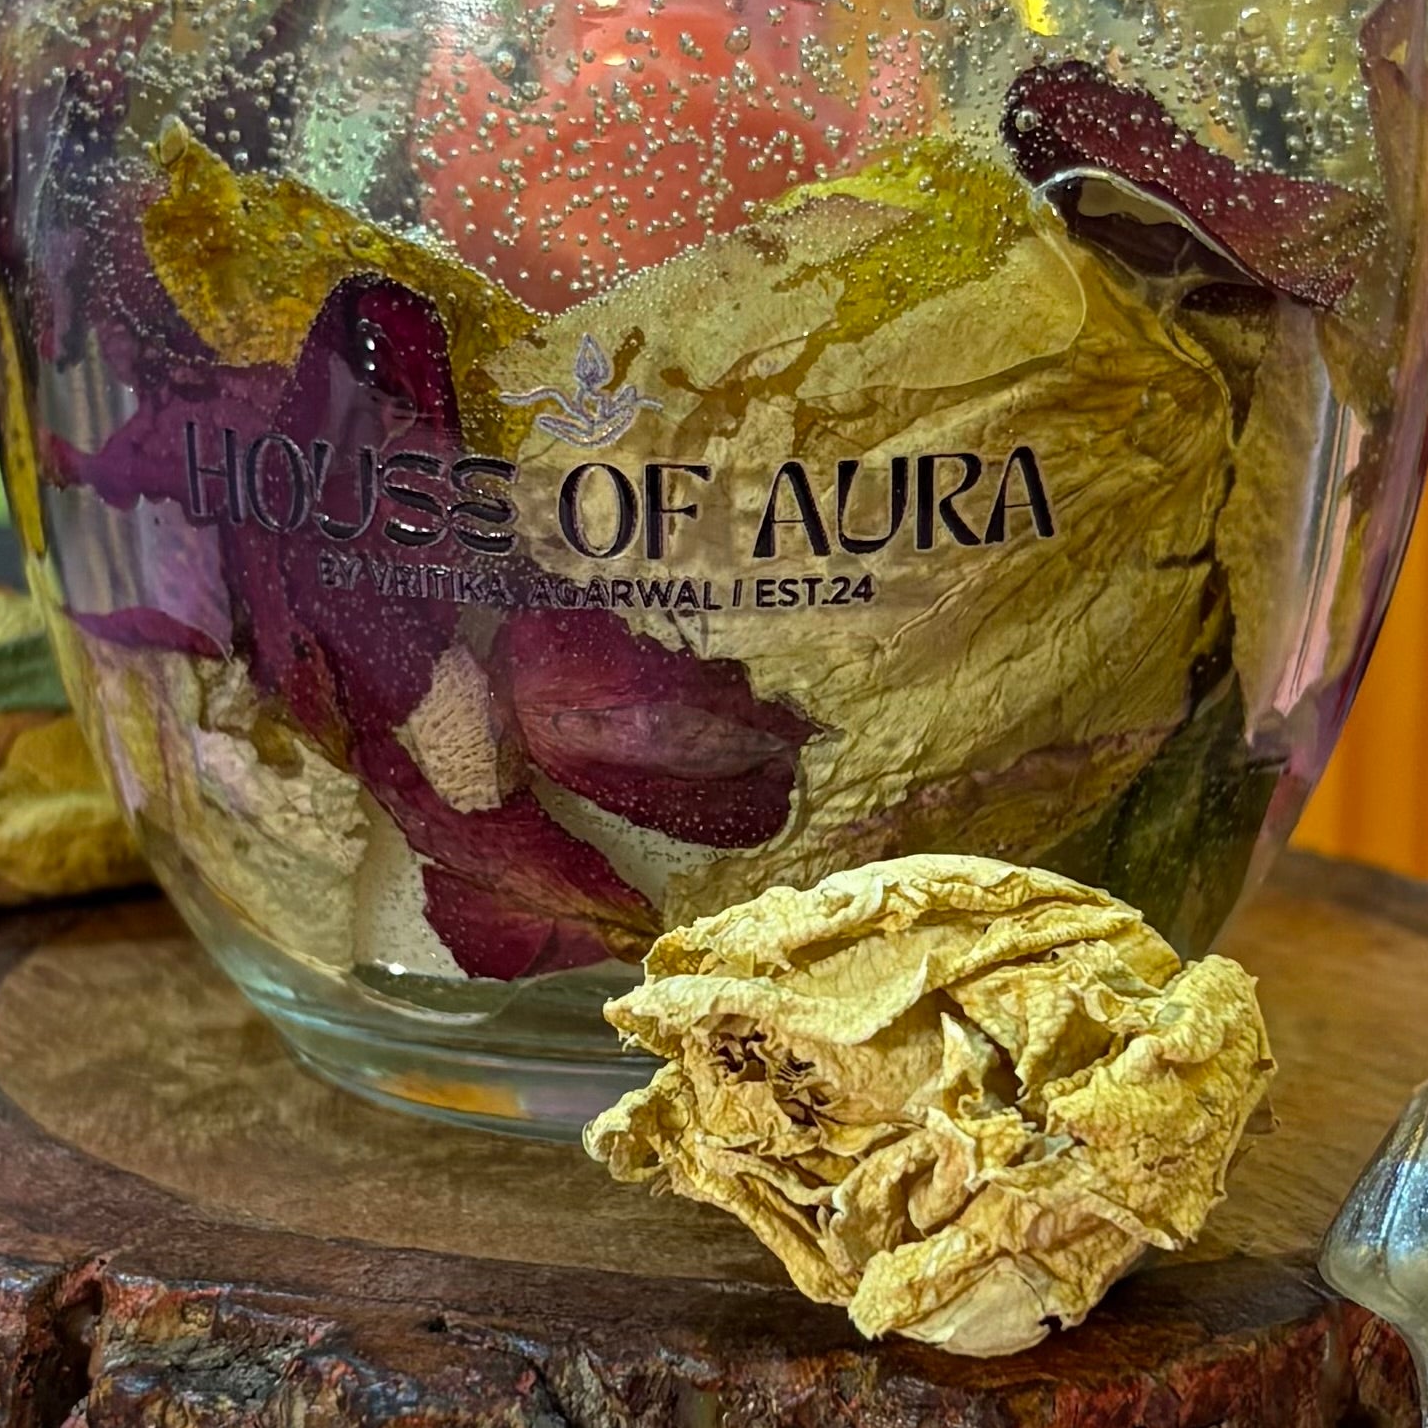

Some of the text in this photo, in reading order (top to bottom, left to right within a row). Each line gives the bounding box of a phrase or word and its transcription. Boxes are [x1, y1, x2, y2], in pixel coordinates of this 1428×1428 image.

[558, 461, 712, 561] OF
[752, 445, 1057, 558] AURA
[318, 555, 362, 590] BY
[371, 563, 516, 606] VRITIKA
[528, 576, 723, 612] AGARWAL
[754, 573, 877, 608] EST.24
